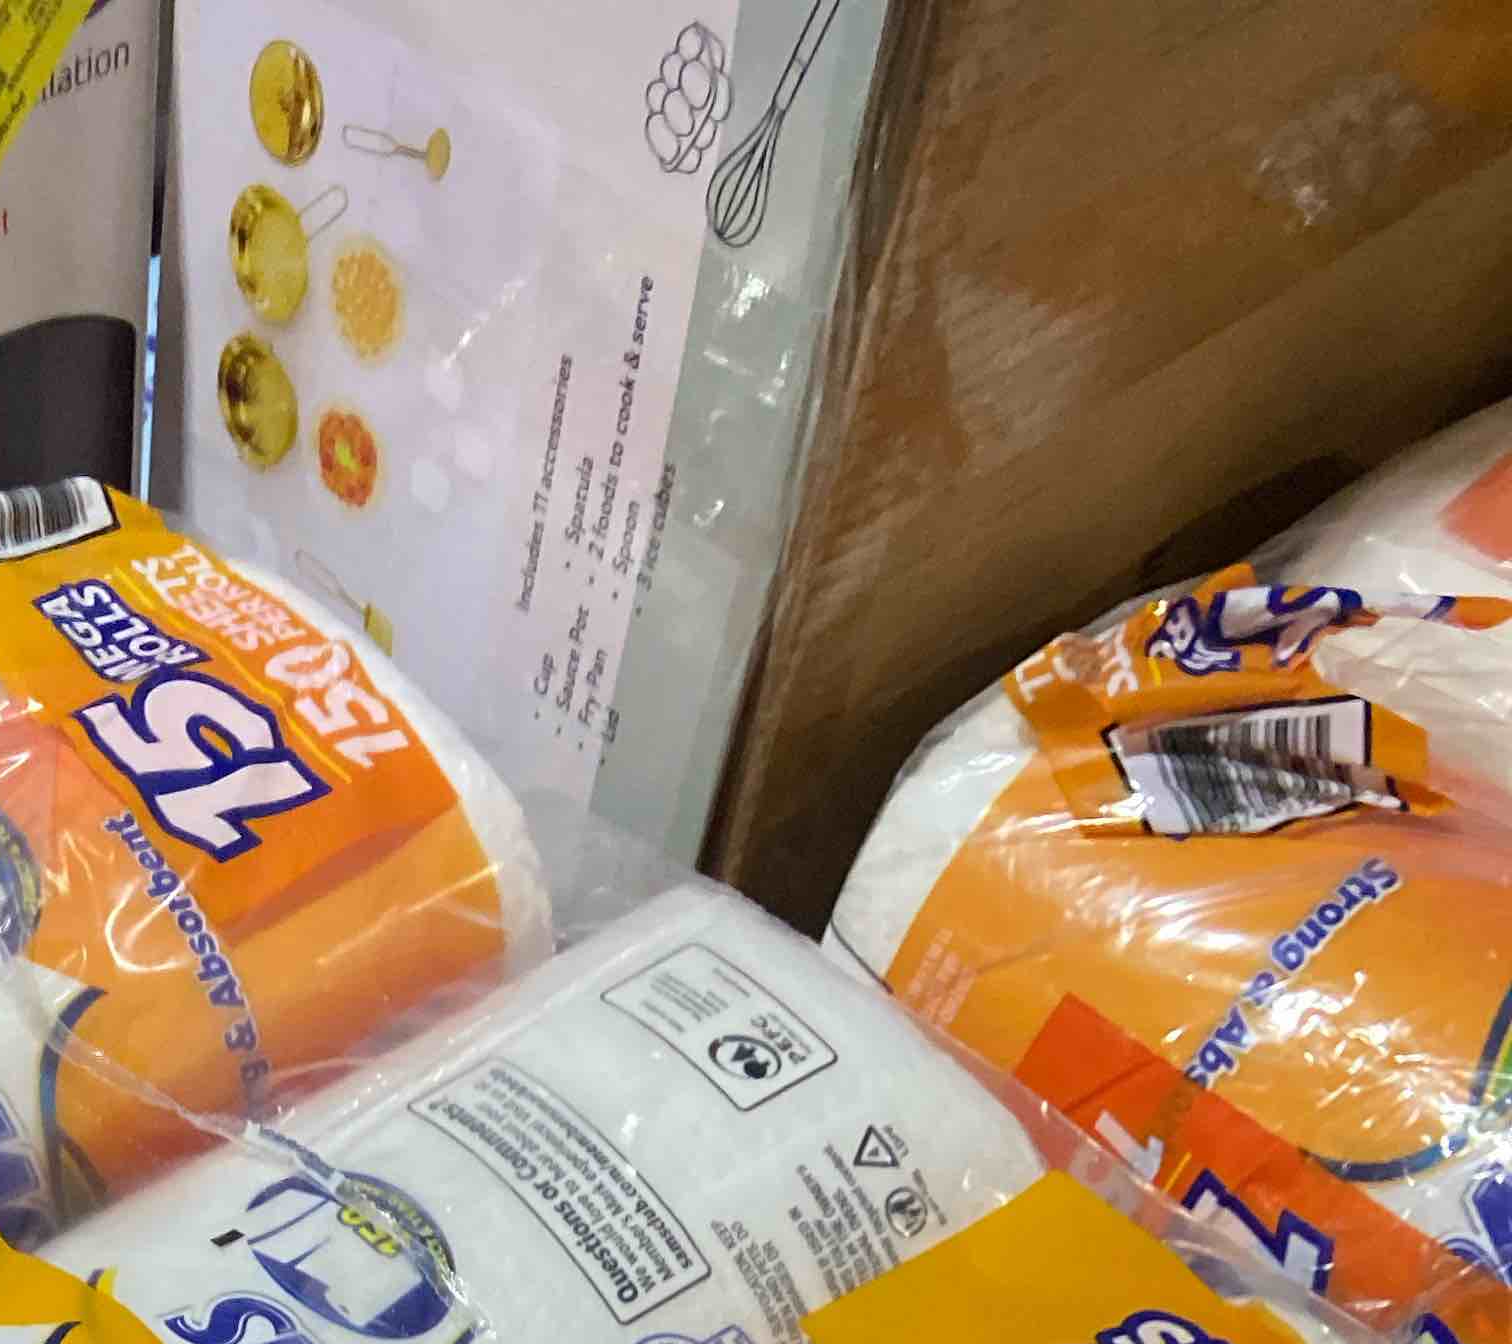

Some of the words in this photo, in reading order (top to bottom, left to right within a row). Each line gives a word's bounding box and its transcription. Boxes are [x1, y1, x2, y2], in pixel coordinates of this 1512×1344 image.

[633, 275, 655, 345] serve
[616, 376, 638, 435] cook
[515, 519, 546, 613] Includes
[542, 353, 574, 489] accessories
[609, 441, 625, 467] to
[564, 456, 594, 545] Spatula
[593, 474, 619, 540] foods
[652, 462, 679, 532] cubes
[611, 500, 642, 575] Spoon
[644, 534, 662, 573] ice
[40, 594, 131, 684] MEGA
[73, 582, 198, 668] ROLLS
[533, 652, 555, 698] Cup
[586, 647, 609, 688] Pan
[265, 637, 411, 769] 150
[75, 668, 334, 863] 15
[102, 810, 246, 1011] Absorbent
[1270, 855, 1401, 973] Strong
[428, 1096, 536, 1178] Comments?
[534, 1148, 568, 1184] hear
[529, 1175, 560, 1207] or
[561, 1177, 581, 1197] to
[573, 1192, 605, 1226] love
[589, 1179, 627, 1219] Mark
[552, 1200, 640, 1306] Questions
[596, 1220, 641, 1269] would
[615, 1212, 680, 1283] Member's
[630, 1263, 660, 1294] We
